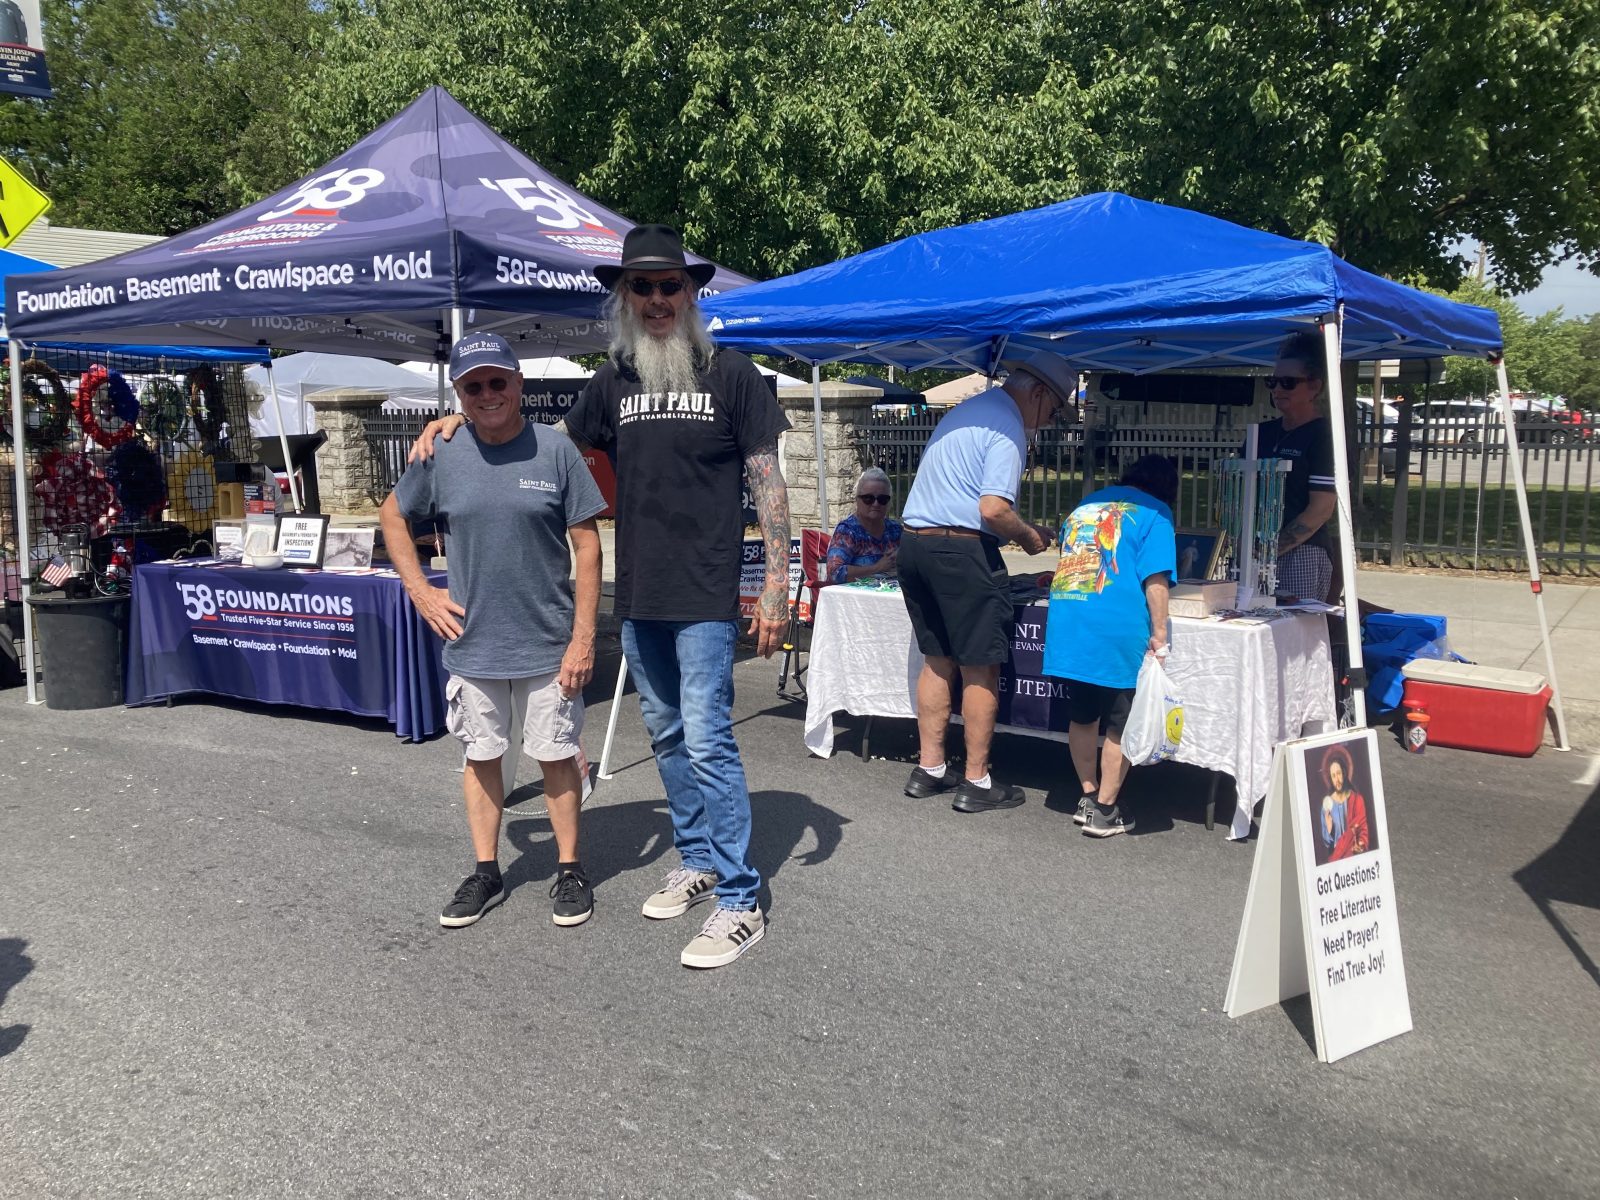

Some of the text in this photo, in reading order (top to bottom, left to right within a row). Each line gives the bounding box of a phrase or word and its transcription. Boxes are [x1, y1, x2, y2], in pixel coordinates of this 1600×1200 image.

[16, 249, 433, 313] Foundation Basement Crawlspace Mold
[495, 255, 611, 295] 58Founda
[557, 393, 574, 407] or
[619, 391, 715, 419] SAINT PAUL
[528, 411, 539, 422] of
[641, 412, 714, 422] EVANGELIZATION
[295, 522, 307, 531] FREE
[285, 539, 314, 547] INSPECTIONS
[215, 589, 354, 616] FOUNDATIONS
[221, 614, 355, 633] Trusted Five-Star Service Since 1958
[192, 634, 357, 660] Basement Crawlspace Foundation Mold
[1015, 641, 1046, 652] EVANG
[1317, 861, 1380, 896] Got Questions?
[1320, 895, 1382, 927] Free Literature
[1323, 920, 1379, 957] Need Prayer?
[1327, 949, 1386, 987] Find True Joy!
